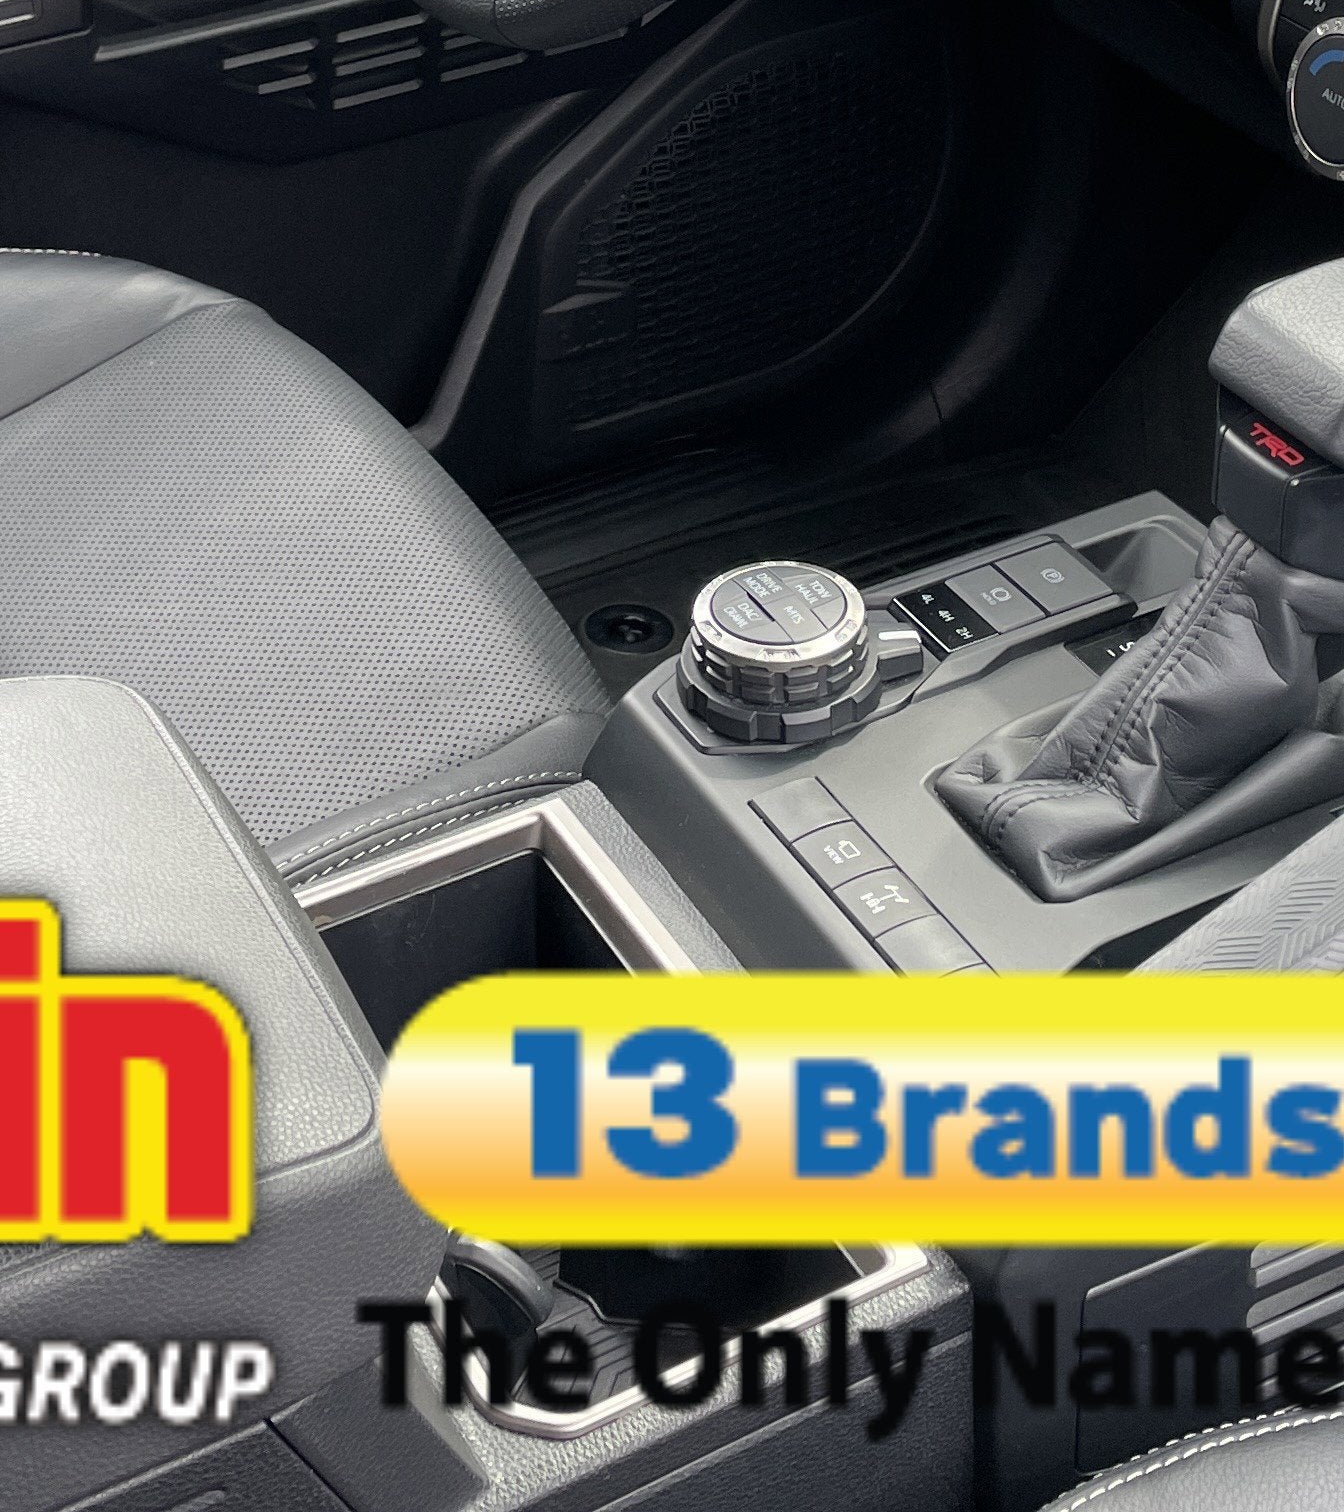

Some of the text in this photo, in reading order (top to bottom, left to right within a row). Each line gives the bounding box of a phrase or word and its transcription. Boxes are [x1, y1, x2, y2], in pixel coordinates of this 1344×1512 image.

[1250, 422, 1305, 466] TRD
[743, 576, 771, 598] MODE
[756, 572, 782, 594] DRIVE
[809, 580, 831, 599] TOW
[796, 584, 819, 606] HAUL
[723, 606, 748, 628] CRAWL
[783, 605, 805, 624] MTS
[938, 609, 955, 622] 4H
[955, 626, 974, 640] 2H
